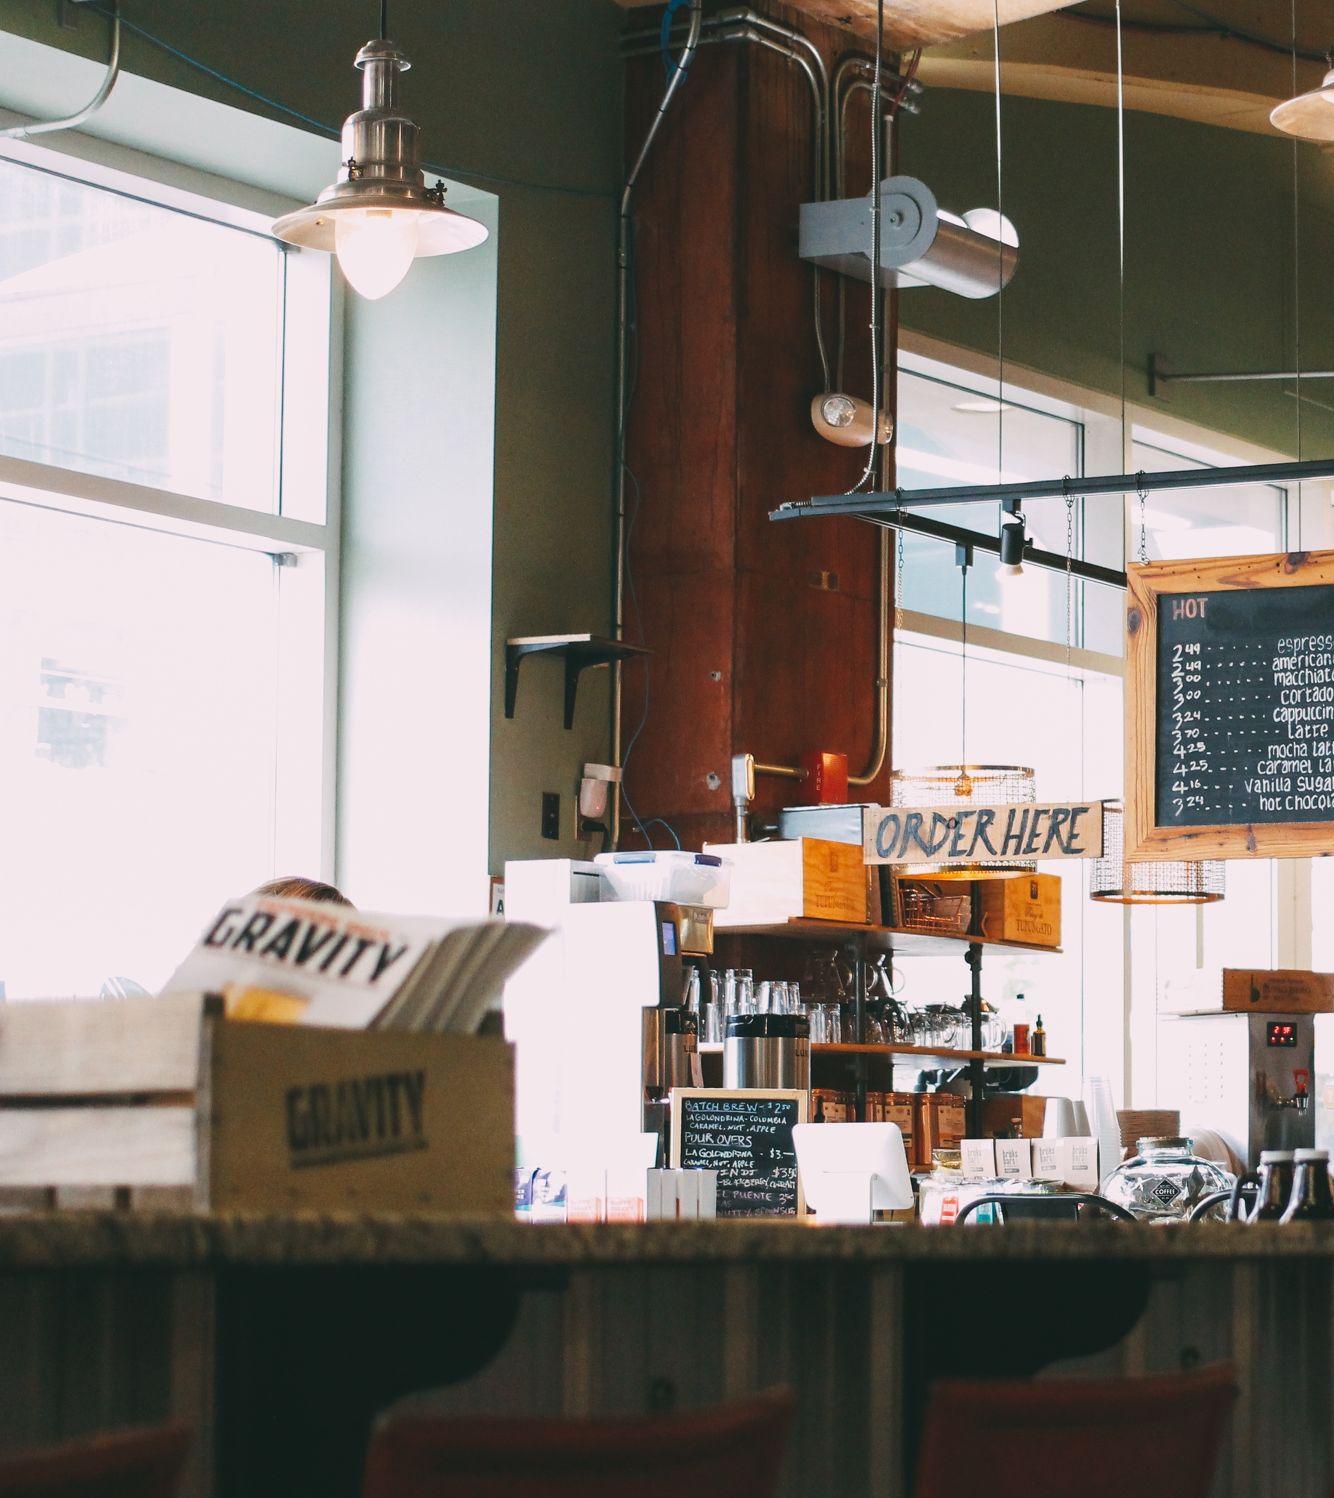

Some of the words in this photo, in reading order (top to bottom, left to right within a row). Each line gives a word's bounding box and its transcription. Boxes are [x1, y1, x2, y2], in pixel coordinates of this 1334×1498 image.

[1172, 598, 1208, 620] HOT
[1280, 686, 1334, 705] cortado
[1288, 721, 1329, 740] latte
[1268, 741, 1308, 759] mocha
[1257, 759, 1312, 774] caramel
[1260, 795, 1282, 811] hot
[876, 807, 997, 858] ORDER
[1000, 805, 1089, 857] HERE
[203, 907, 408, 984] GRAVITY
[286, 1070, 427, 1153] GRAVITY
[685, 1101, 719, 1111] BATCH
[723, 1102, 758, 1112] BREW
[685, 1132, 714, 1144] POUR
[717, 1134, 752, 1147] OVERS
[733, 1191, 772, 1201] PUENTE
